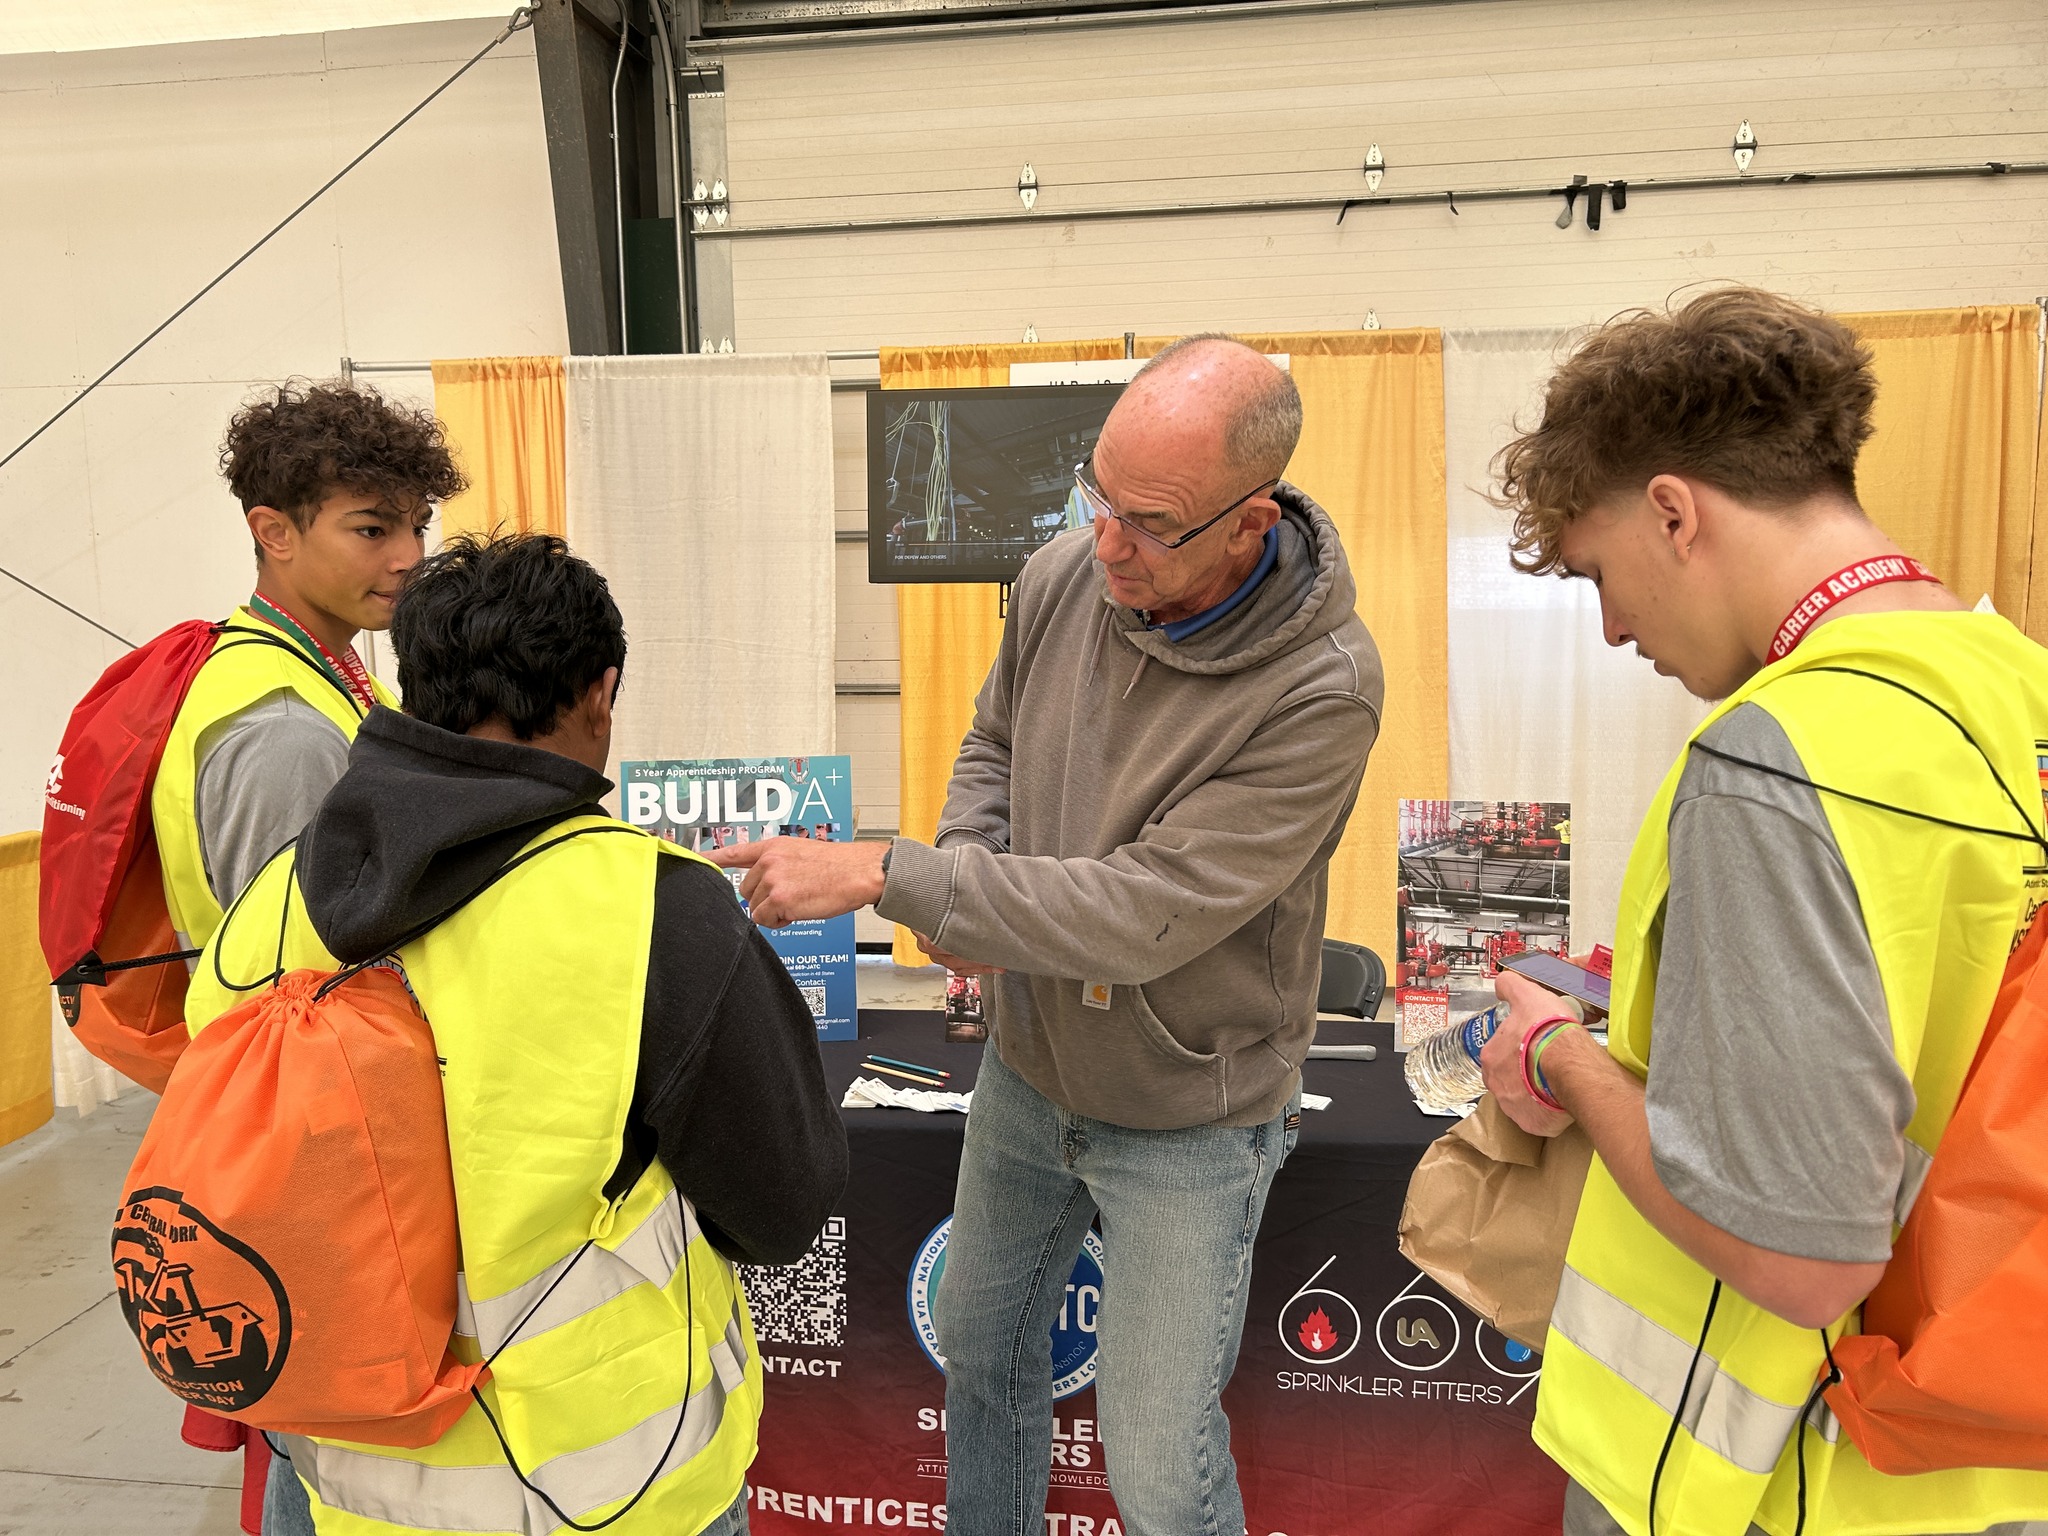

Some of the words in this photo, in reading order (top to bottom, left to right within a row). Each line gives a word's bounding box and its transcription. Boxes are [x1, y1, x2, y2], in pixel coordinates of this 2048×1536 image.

[1772, 590, 1831, 658] CAREER
[1826, 556, 1910, 600] ACADEMY
[635, 769, 641, 777] 5
[643, 768, 664, 778] Year
[666, 766, 736, 778] Apprenticeship
[739, 765, 785, 775] PROGRAM
[627, 778, 793, 826] BUILD
[791, 929, 822, 937] rewarding
[796, 955, 818, 964] OUR
[819, 954, 849, 963] TEAM!
[795, 979, 827, 987] Contact:
[918, 1227, 950, 1282] NATIONA
[916, 1300, 926, 1318] UA
[921, 1323, 939, 1352] ROA
[760, 1355, 842, 1378] NTACT
[204, 1393, 235, 1406] DAY
[1276, 1371, 1404, 1398] SPRINKLER
[1411, 1380, 1503, 1405] FITTERS
[917, 1463, 948, 1474] ATTIT
[1050, 1473, 1108, 1486] NOWLED
[748, 1485, 947, 1531] RENTICES
